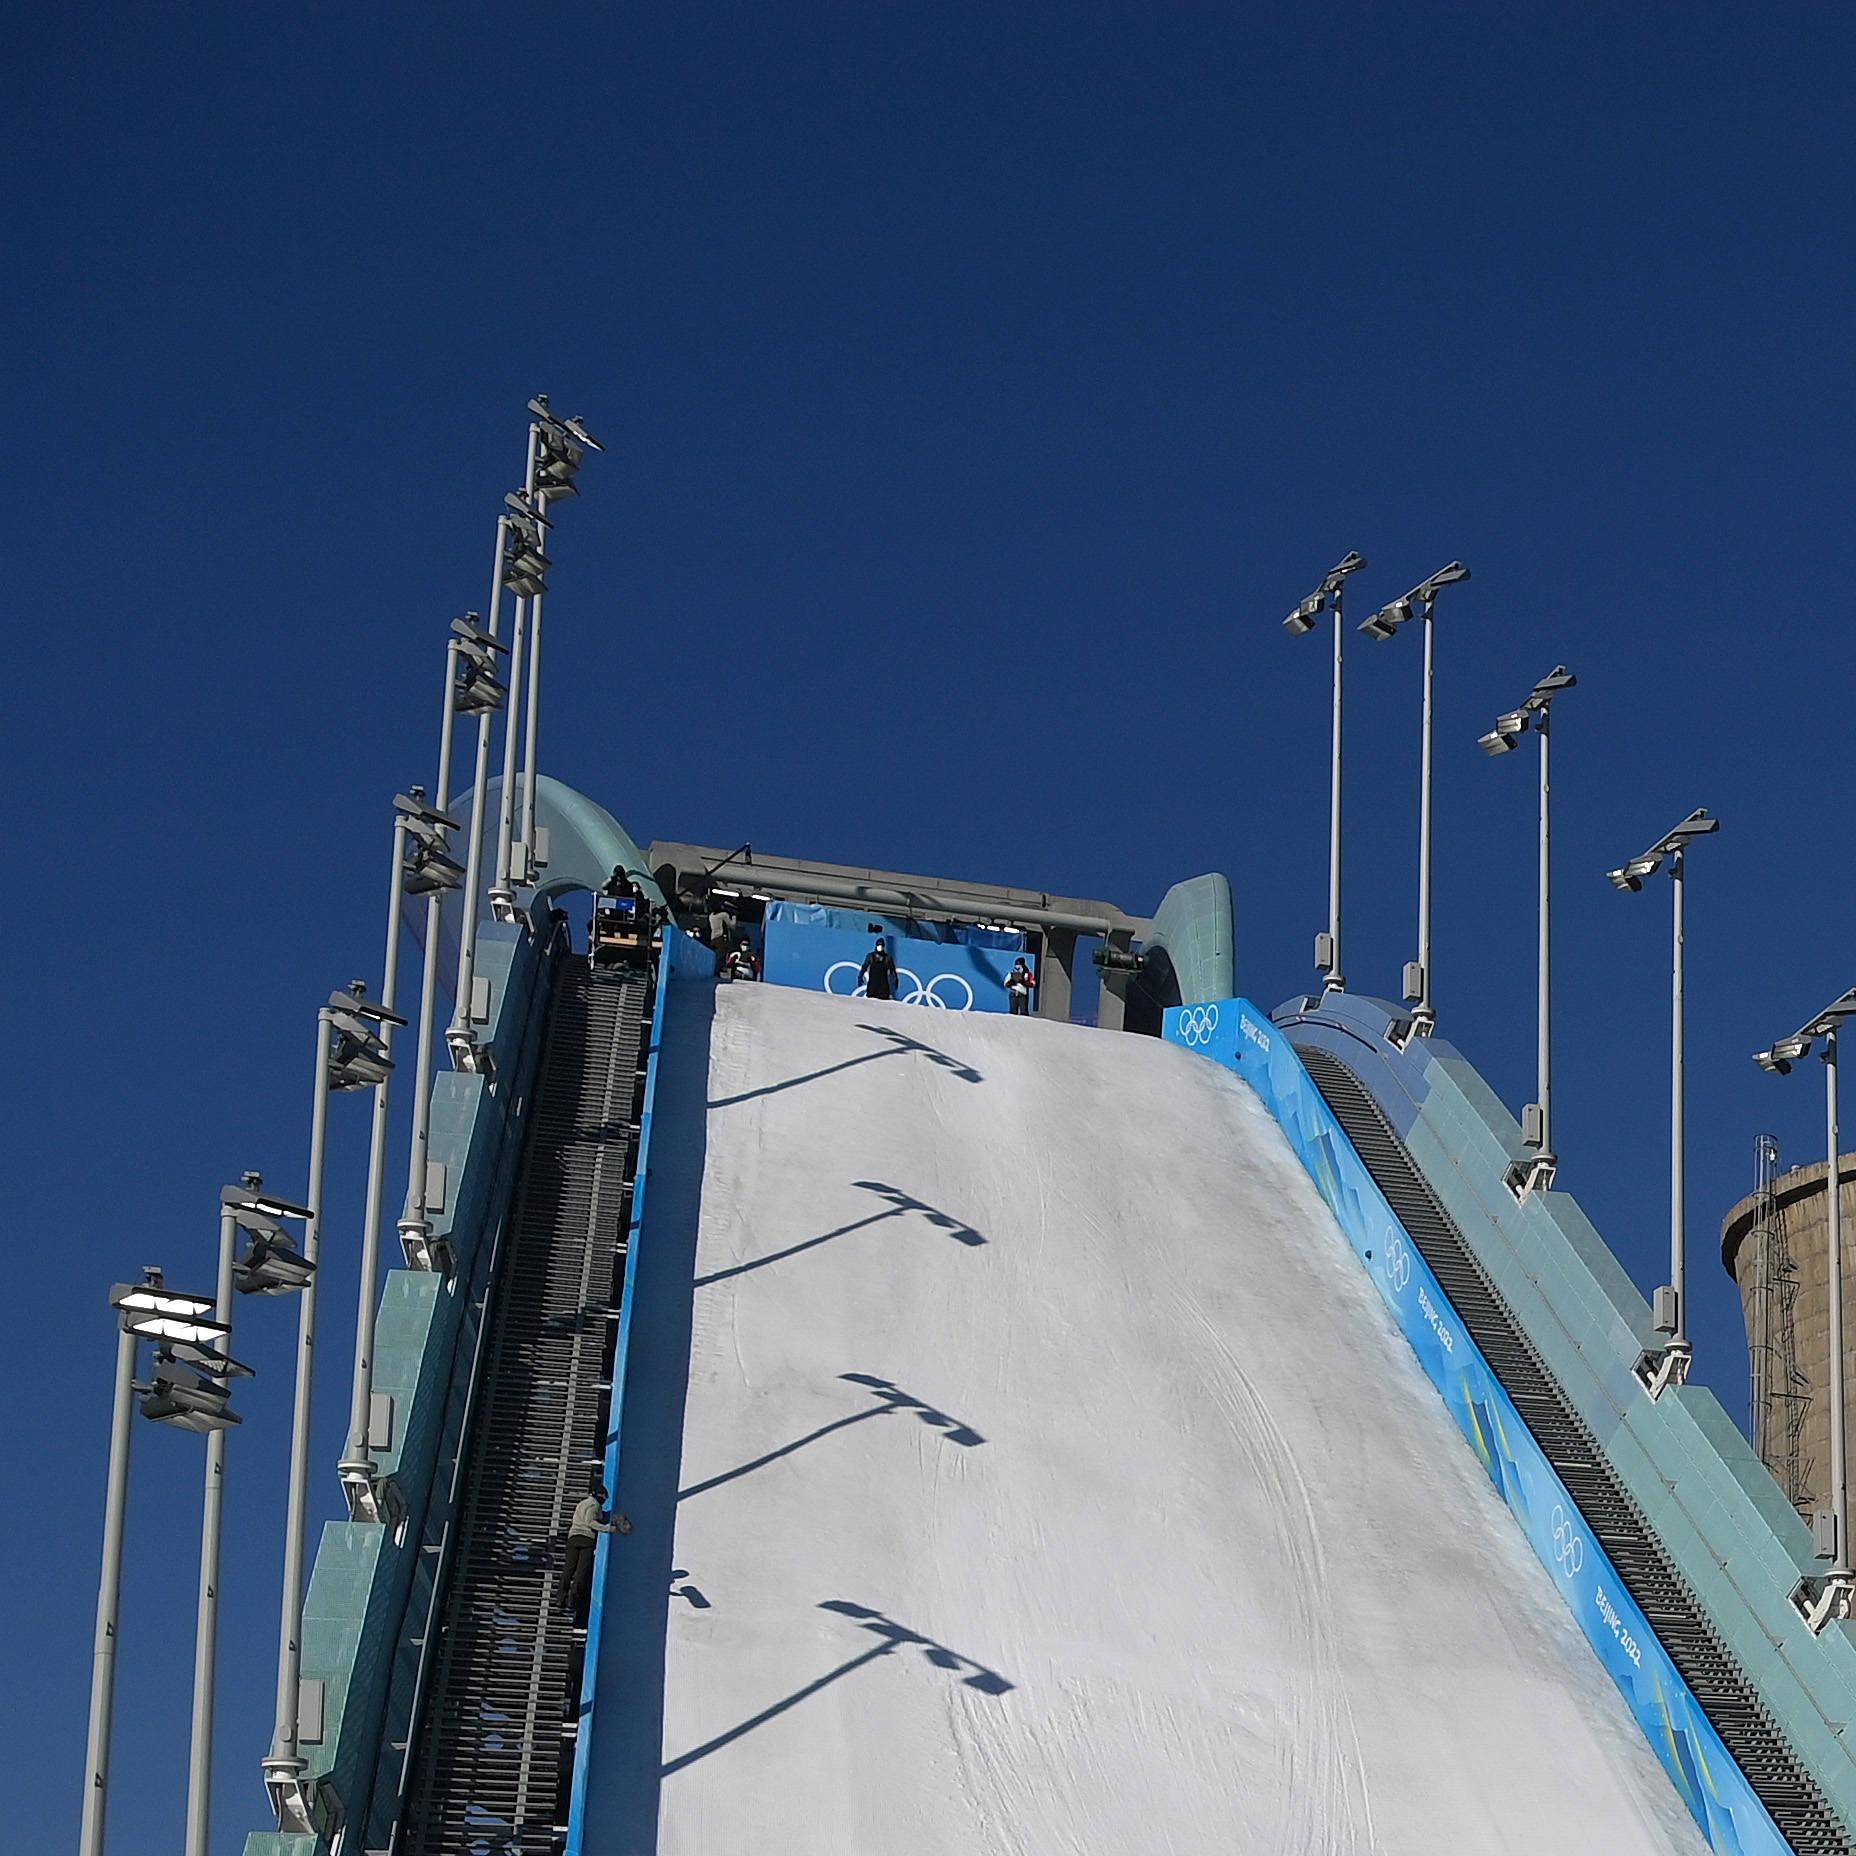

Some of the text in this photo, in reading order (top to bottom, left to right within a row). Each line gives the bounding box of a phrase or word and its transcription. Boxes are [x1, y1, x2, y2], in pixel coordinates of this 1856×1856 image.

[1437, 1320, 1453, 1353] 2022
[1596, 1585, 1641, 1669] BEIJING 2022
